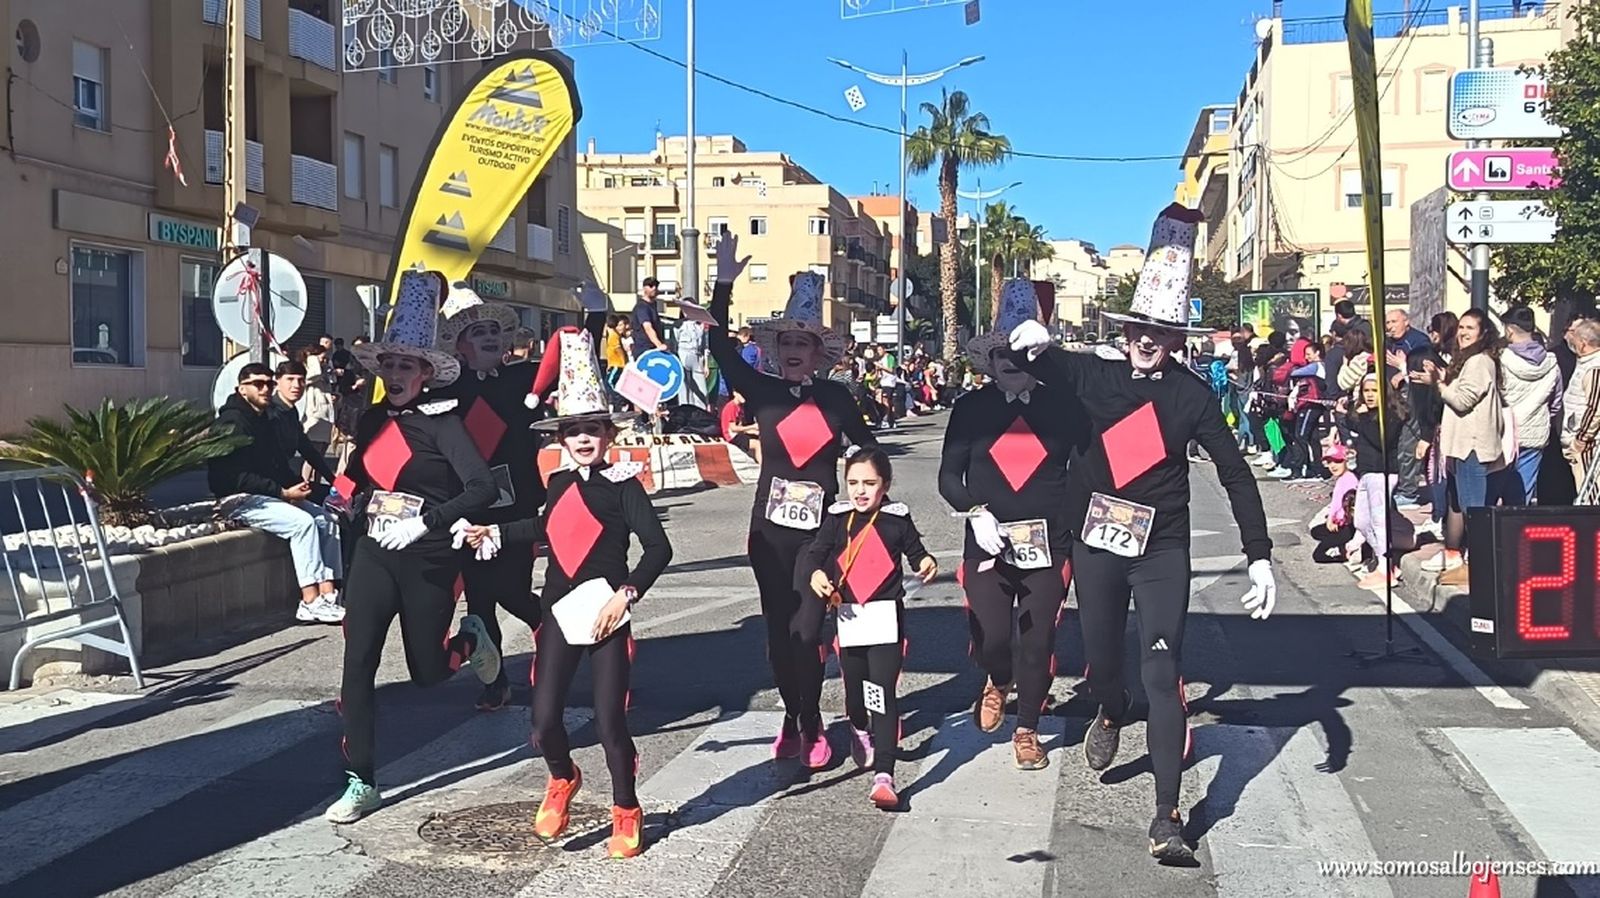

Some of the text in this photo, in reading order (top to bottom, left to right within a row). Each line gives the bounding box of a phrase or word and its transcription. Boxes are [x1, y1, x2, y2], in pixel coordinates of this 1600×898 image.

[461, 133, 541, 156] EVENTOS DEPORTIVOS
[469, 145, 530, 164] TURISMO ACTIVO
[478, 157, 516, 170] OUTDOOR
[162, 222, 216, 247] BYSPANI
[780, 504, 809, 521] 166
[1099, 524, 1132, 549] 172
[1017, 546, 1038, 562] 65
[1517, 525, 1600, 640] 2
